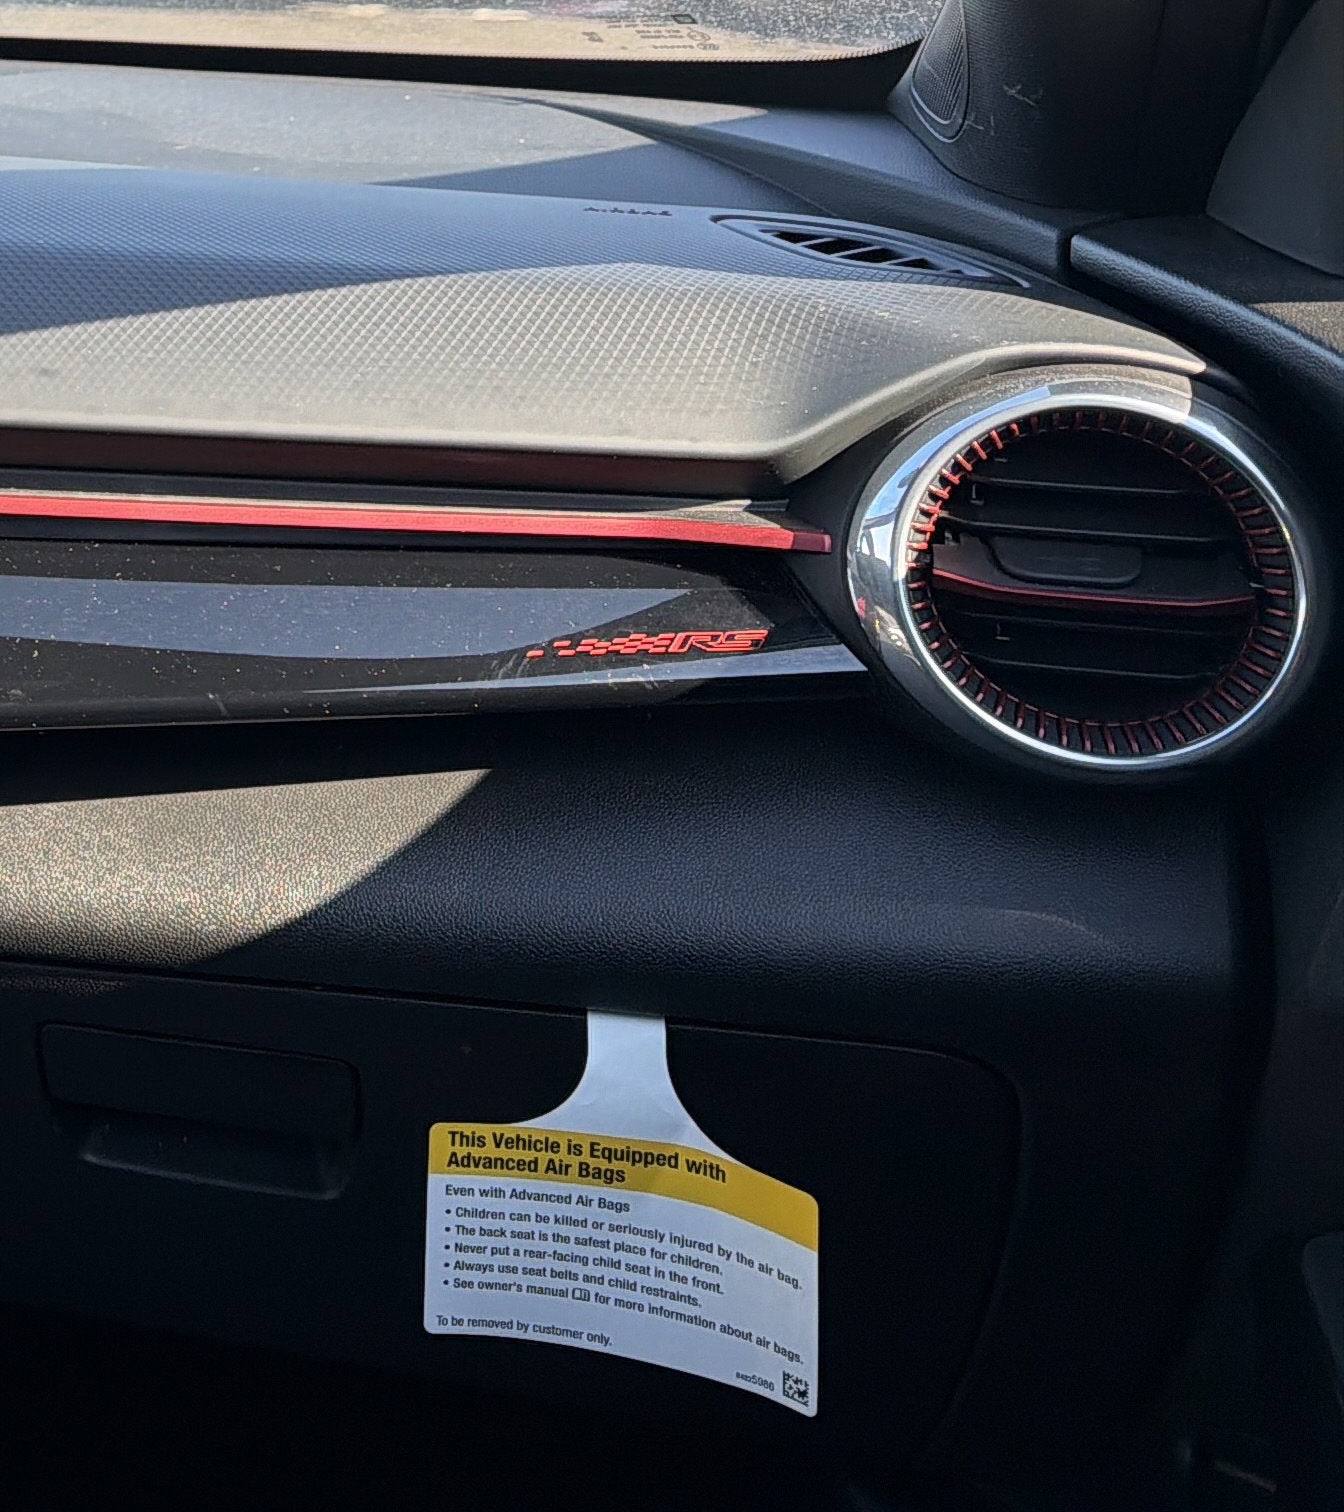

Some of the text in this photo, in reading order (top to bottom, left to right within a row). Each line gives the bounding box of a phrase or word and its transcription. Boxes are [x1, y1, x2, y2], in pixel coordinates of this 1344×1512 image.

[669, 629, 769, 654] RS
[447, 1152, 626, 1184] Advanced Air Bags
[448, 1130, 726, 1183] This Vehicle is Equipped with
[445, 1185, 630, 1213] Even with Advanced Air Bags
[455, 1225, 723, 1276] The back seat is the safest place for children.
[455, 1242, 724, 1296] Never put a rear-facing child seat in the front.
[456, 1207, 802, 1290] Children can be killed or seriously injured by the air bag.
[453, 1260, 702, 1308] Always use seat belts and child restraints.
[436, 1315, 612, 1346] To be removed by customer only.
[453, 1278, 804, 1365] See owner's manual for more information about air bags.
